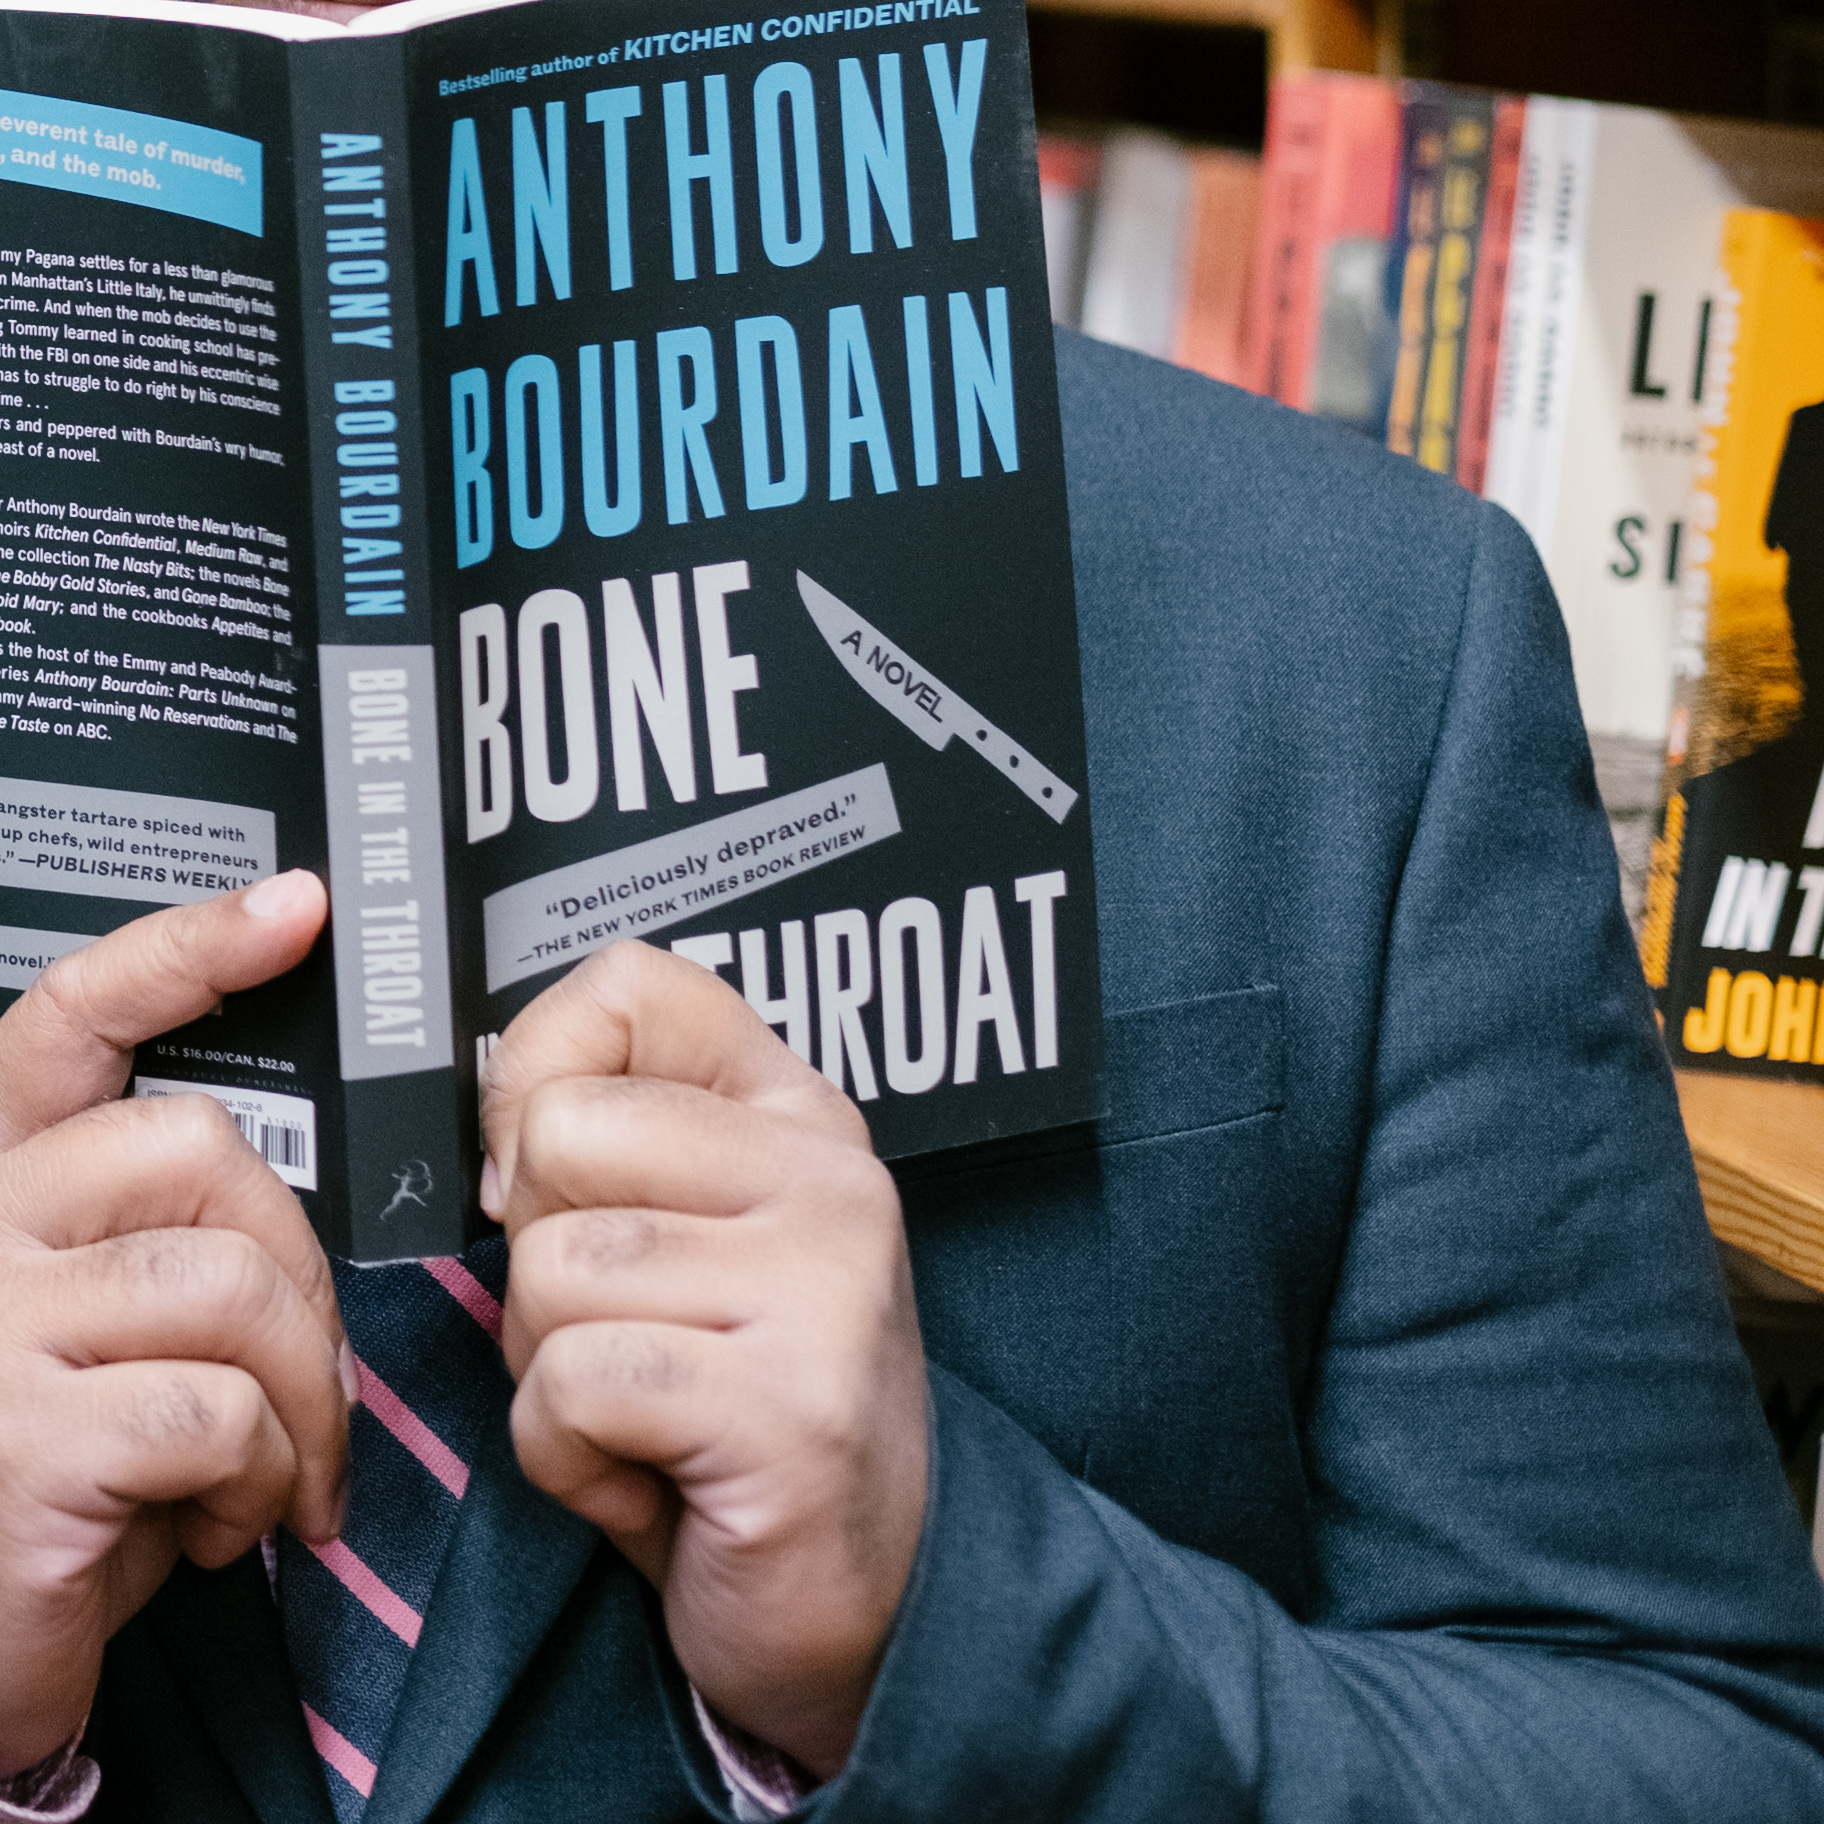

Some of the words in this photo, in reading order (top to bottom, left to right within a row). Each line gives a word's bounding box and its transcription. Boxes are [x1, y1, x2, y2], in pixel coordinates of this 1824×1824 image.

[439, 63, 528, 96] Bestselling
[531, 52, 593, 79] author
[597, 46, 619, 67] of
[624, 22, 753, 62] KITCHEN
[10, 147, 57, 171] and
[62, 152, 101, 179] the
[106, 164, 161, 191] mob.
[93, 128, 138, 156] tale
[143, 140, 169, 161] of
[170, 148, 244, 182] murder,
[444, 38, 989, 328] ANTHONY
[320, 131, 392, 350] ANTHONY
[27, 440, 43, 458] of
[46, 445, 56, 459] a
[58, 446, 101, 464] novel.
[450, 286, 1019, 570] BOURDAIN
[333, 379, 406, 617] BOURDAIN
[460, 560, 769, 844] BONE
[840, 627, 868, 658] A
[866, 646, 945, 724] NOVEL
[10, 713, 51, 735] Taste
[53, 721, 73, 737] on
[75, 721, 112, 741] ABC.
[347, 667, 411, 765] BONE
[70, 807, 138, 830] tartare
[142, 817, 203, 837] spiced
[207, 824, 246, 844] with
[359, 781, 407, 816] IN
[18, 852, 167, 884] —PUBLISHERS
[27, 828, 83, 851] chefs,
[86, 836, 125, 854] wild
[130, 842, 259, 872] entrepreneurs
[360, 829, 414, 886] THE
[545, 852, 710, 918] “Deliciously
[717, 793, 857, 864] depraved.”
[517, 935, 573, 962] —THE
[577, 917, 621, 944] NEW
[626, 897, 677, 925] YORK
[681, 875, 739, 907] TIMES
[743, 854, 796, 884] BOOK
[799, 824, 866, 862] REVIEW
[360, 900, 425, 1048] THROAT
[157, 1044, 179, 1056] U.S.
[183, 1048, 255, 1067] $16.00/CAN.
[258, 1057, 295, 1073] $22.00
